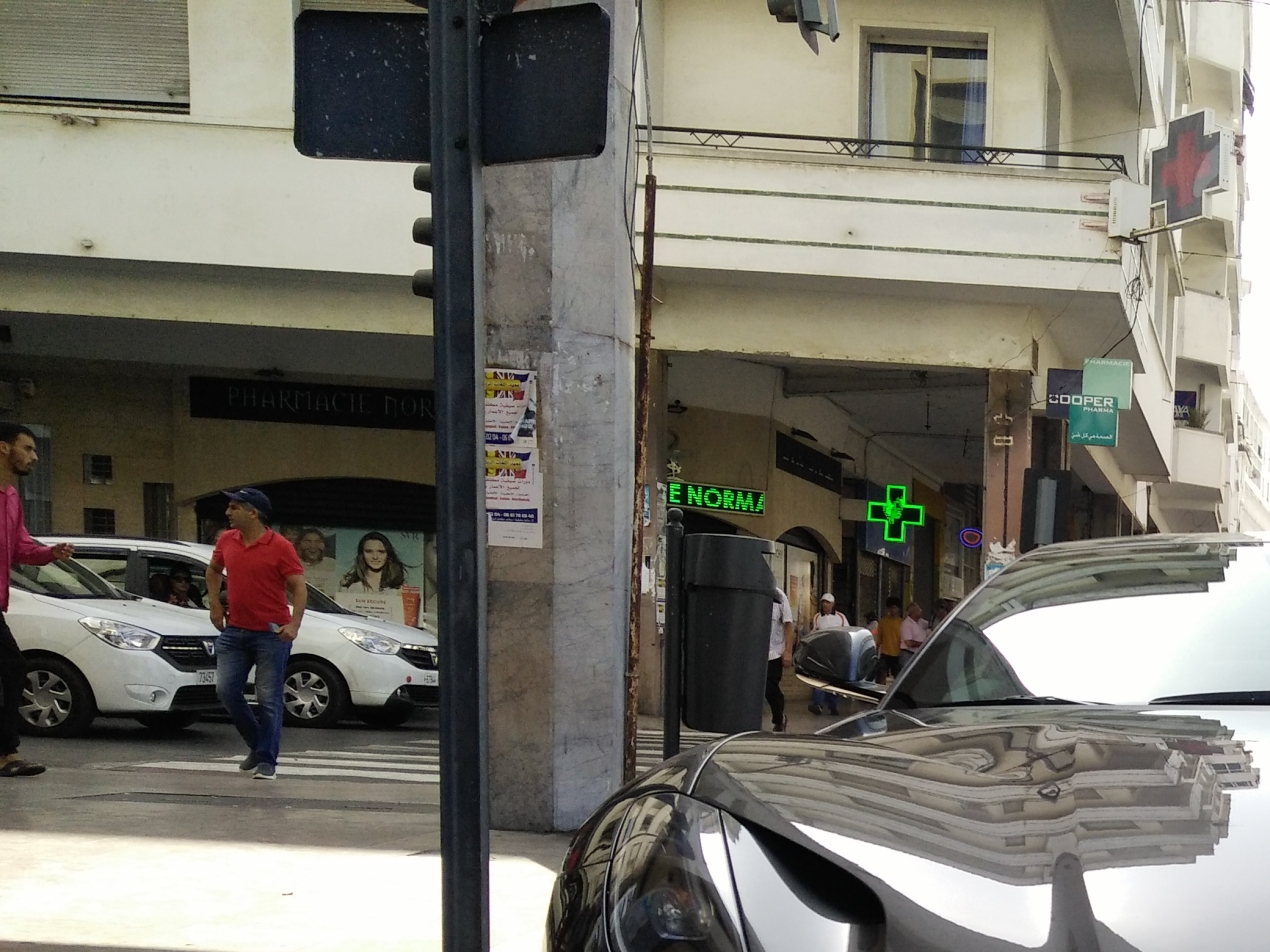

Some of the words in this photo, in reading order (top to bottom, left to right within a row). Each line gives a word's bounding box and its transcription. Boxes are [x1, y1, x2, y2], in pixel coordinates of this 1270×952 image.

[228, 386, 372, 414] PHARMACIE
[1048, 394, 1114, 407] COOPER
[1083, 406, 1114, 414] PHARMA
[669, 482, 681, 503] E
